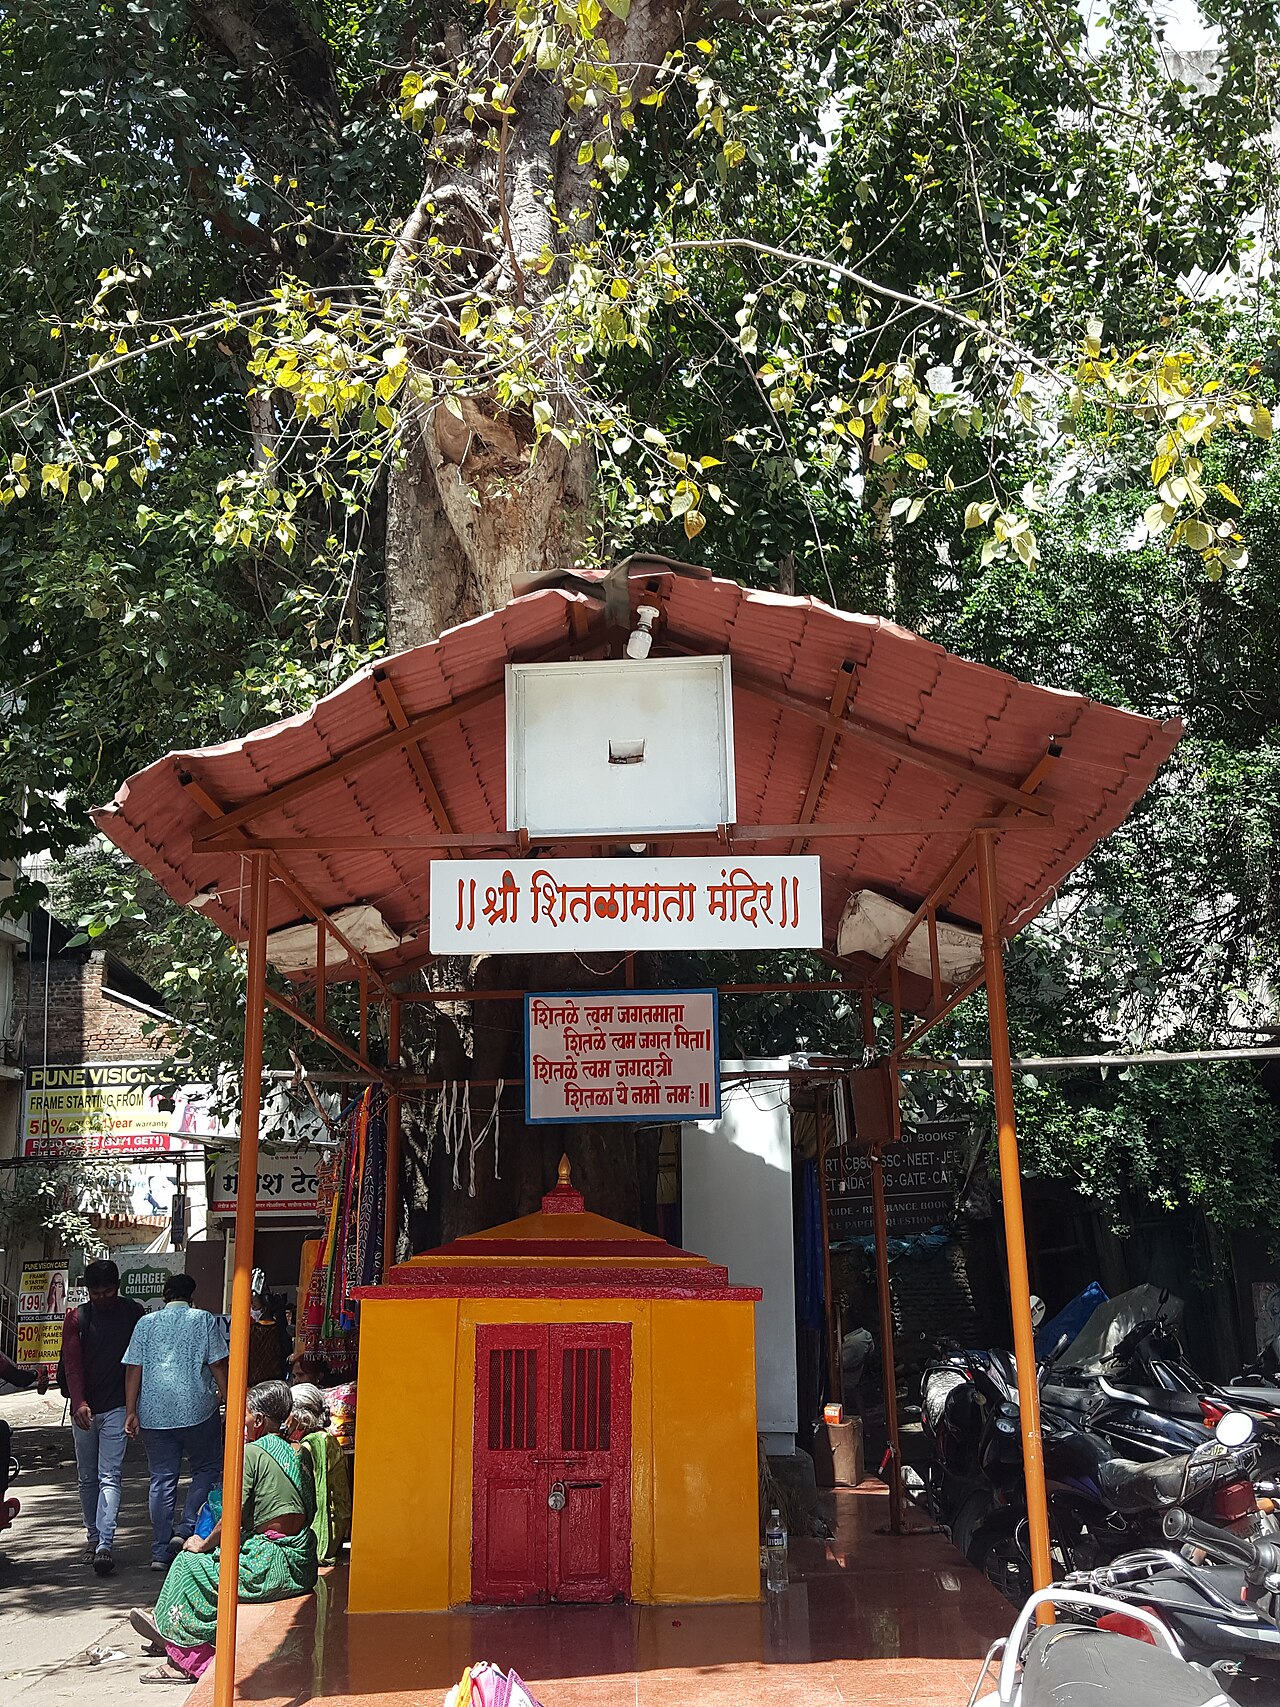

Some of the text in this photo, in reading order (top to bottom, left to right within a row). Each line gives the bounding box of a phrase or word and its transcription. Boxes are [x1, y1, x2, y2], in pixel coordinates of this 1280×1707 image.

[530, 870, 697, 927] शितळामाता
[531, 999, 685, 1029] शितळे त्वम जगतमाता
[563, 1026, 606, 1056] शितळे
[609, 1032, 638, 1051] त्वम
[638, 1031, 671, 1051] जगत
[533, 1054, 578, 1084] शितळे
[581, 1060, 612, 1079] त्वम
[31, 1069, 86, 1087] PUNE
[30, 1095, 64, 1110] FRAME
[66, 1093, 114, 1109] STARTING
[116, 1093, 144, 1108] FROM
[564, 1082, 614, 1112] शितळा
[616, 1081, 628, 1105] ये
[631, 1080, 661, 1104] नमो
[29, 1119, 65, 1135] 50%
[136, 1120, 168, 1129] warranty
[918, 1132, 955, 1142] BOOKS
[907, 1152, 934, 1166] NEET
[899, 1172, 926, 1186] GATE
[829, 1206, 854, 1216] UIDE
[24, 1263, 38, 1271] PUNE
[54, 1261, 68, 1269] CARE
[128, 1272, 166, 1284] GARGEE
